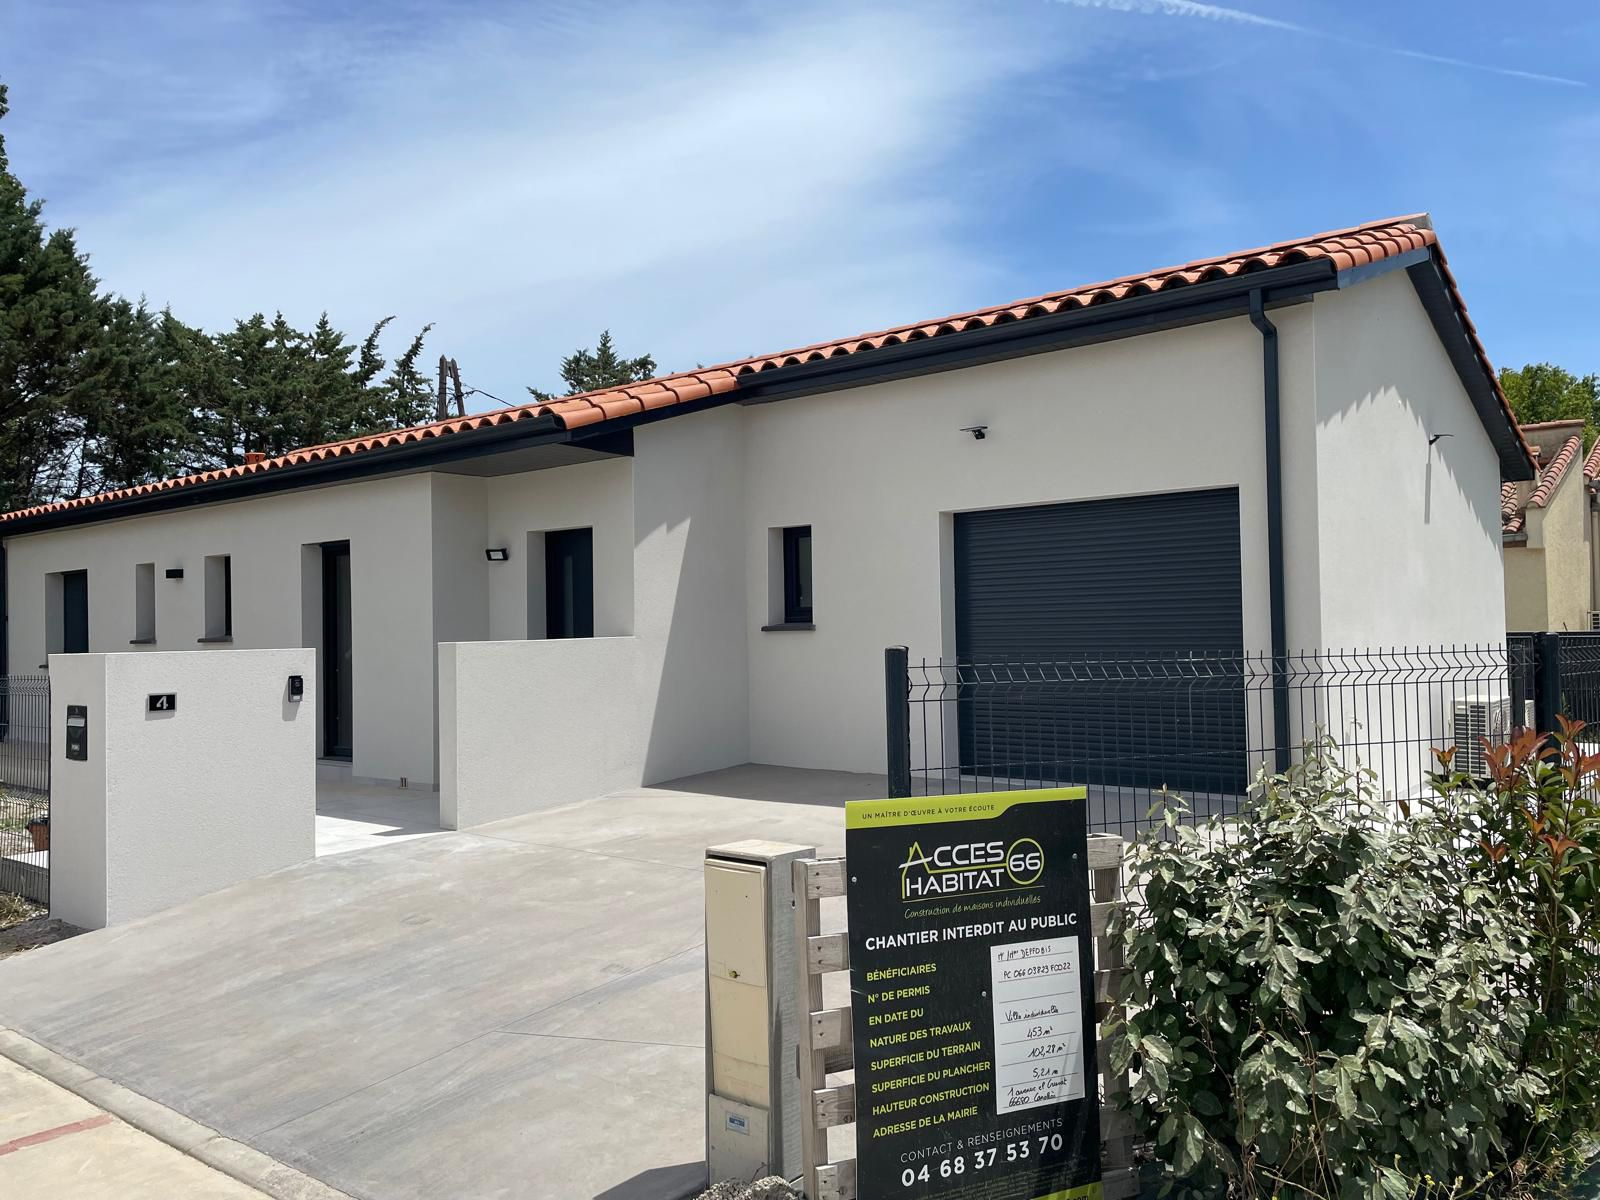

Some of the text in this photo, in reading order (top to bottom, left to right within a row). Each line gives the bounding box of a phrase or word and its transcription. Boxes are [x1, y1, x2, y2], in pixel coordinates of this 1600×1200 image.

[156, 695, 168, 709] 4
[874, 811, 901, 819] MAÎTRE
[903, 808, 936, 817] D'ŒUVRE
[968, 804, 996, 812] ÉCOUTE
[1009, 852, 1041, 872] 66
[905, 869, 1005, 897] HABITAT
[904, 895, 1041, 919] Construction de maisons individuelles
[865, 912, 1078, 951] CHANTIER INTERDIT AU PUBLIC
[866, 963, 937, 981] BÉNÉFICIAIRES
[881, 991, 895, 1000] DE
[896, 985, 931, 999] PERMIS
[868, 1008, 924, 1026] EN DATE DU
[869, 1021, 972, 1048] NATURE DES TRAVAUX
[1027, 1026, 1042, 1038] 453
[870, 1041, 981, 1071] SUPERFICIE DU TERRAIN
[871, 1061, 991, 1093] SUPERFICIE DU PLANCHER
[872, 1082, 990, 1116] HAUTEUR CONSTRUCTION
[873, 1105, 978, 1139] ADRESSE DE LA MAIRIE
[900, 1117, 1064, 1163] CONTACT & RENSEIGNEMENTS
[901, 1164, 931, 1188] 04
[939, 1156, 966, 1178] 68
[974, 1148, 998, 1170] 37
[1006, 1141, 1030, 1161] 53
[1038, 1133, 1064, 1154] 70
